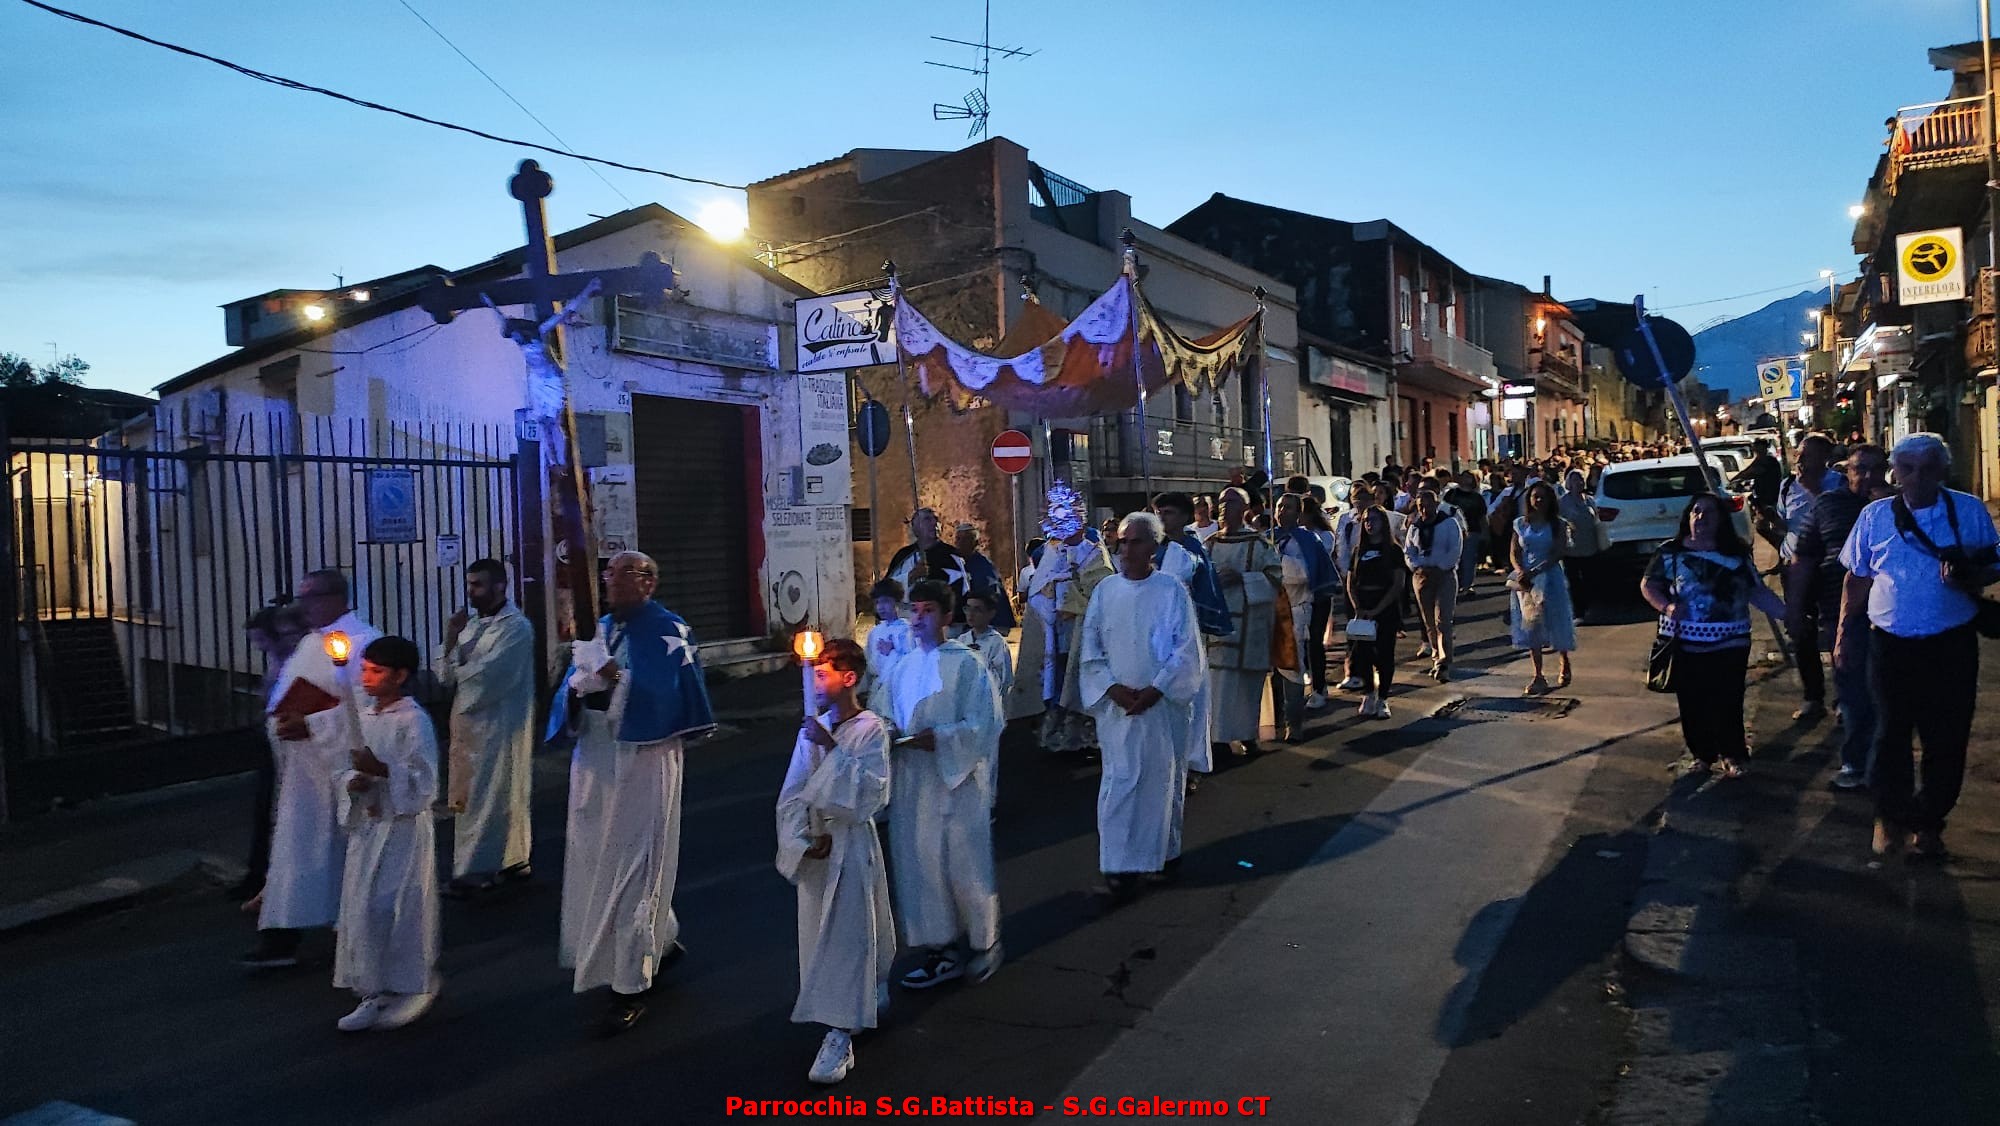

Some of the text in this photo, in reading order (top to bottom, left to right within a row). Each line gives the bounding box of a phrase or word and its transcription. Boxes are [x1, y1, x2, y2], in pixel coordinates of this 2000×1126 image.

[1902, 281, 1962, 298] INTERFLORA
[771, 511, 812, 527] SELEZIONATE
[816, 506, 844, 521] OFFERTE
